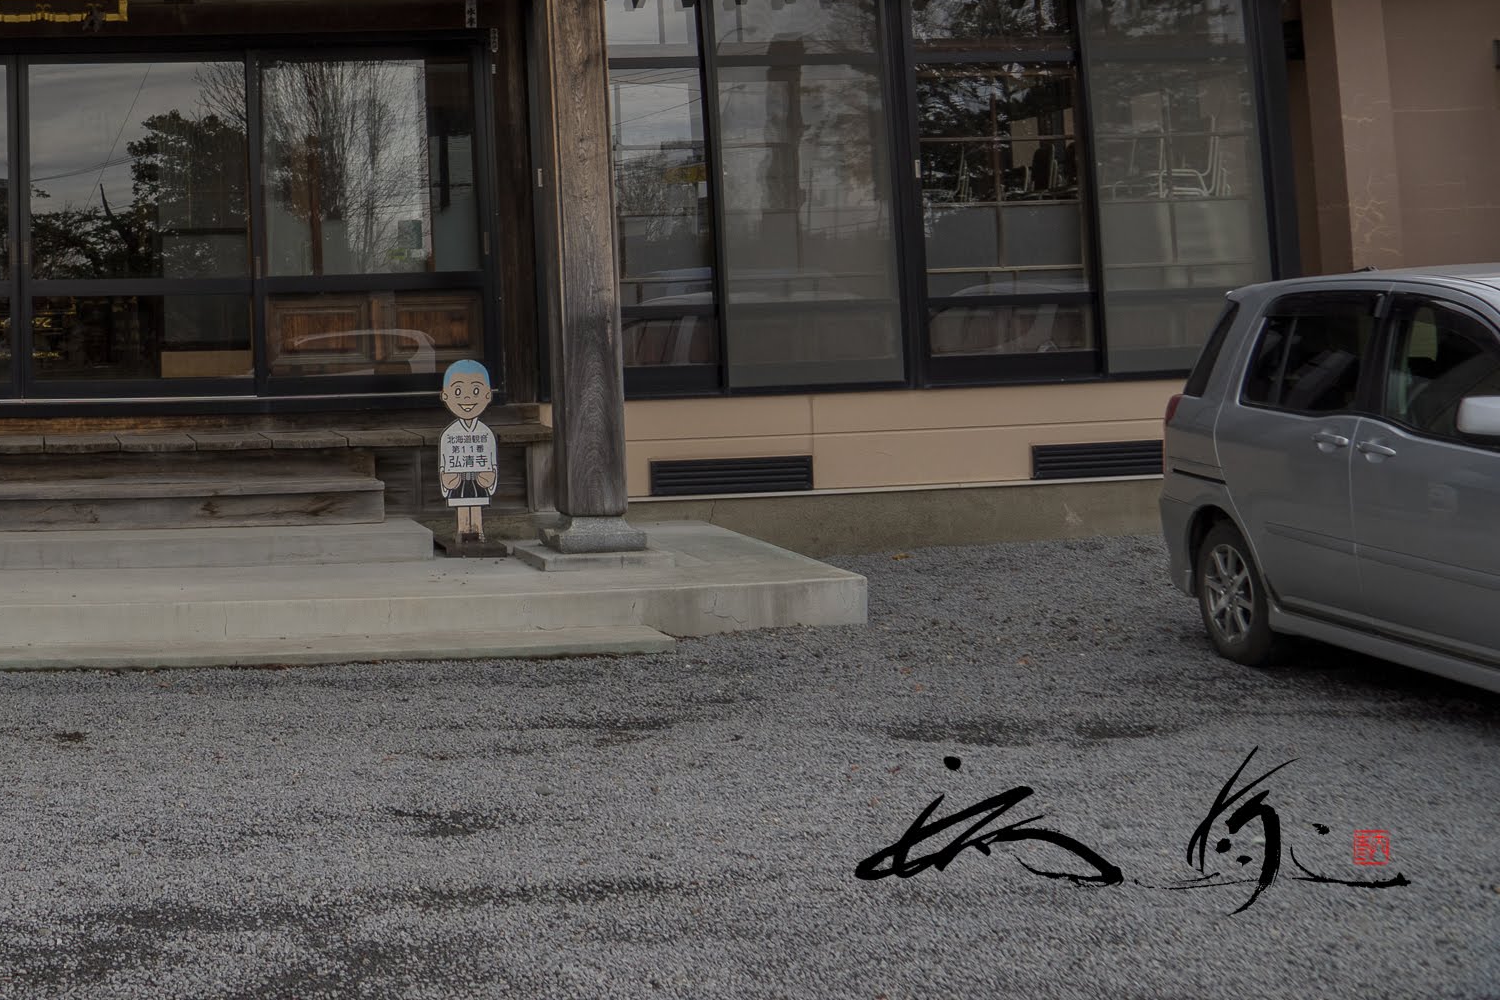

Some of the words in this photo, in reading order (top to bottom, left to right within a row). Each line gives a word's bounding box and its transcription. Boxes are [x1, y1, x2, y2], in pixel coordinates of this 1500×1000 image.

[447, 434, 488, 444] 北海道観音
[449, 455, 488, 468] 弘清寺
